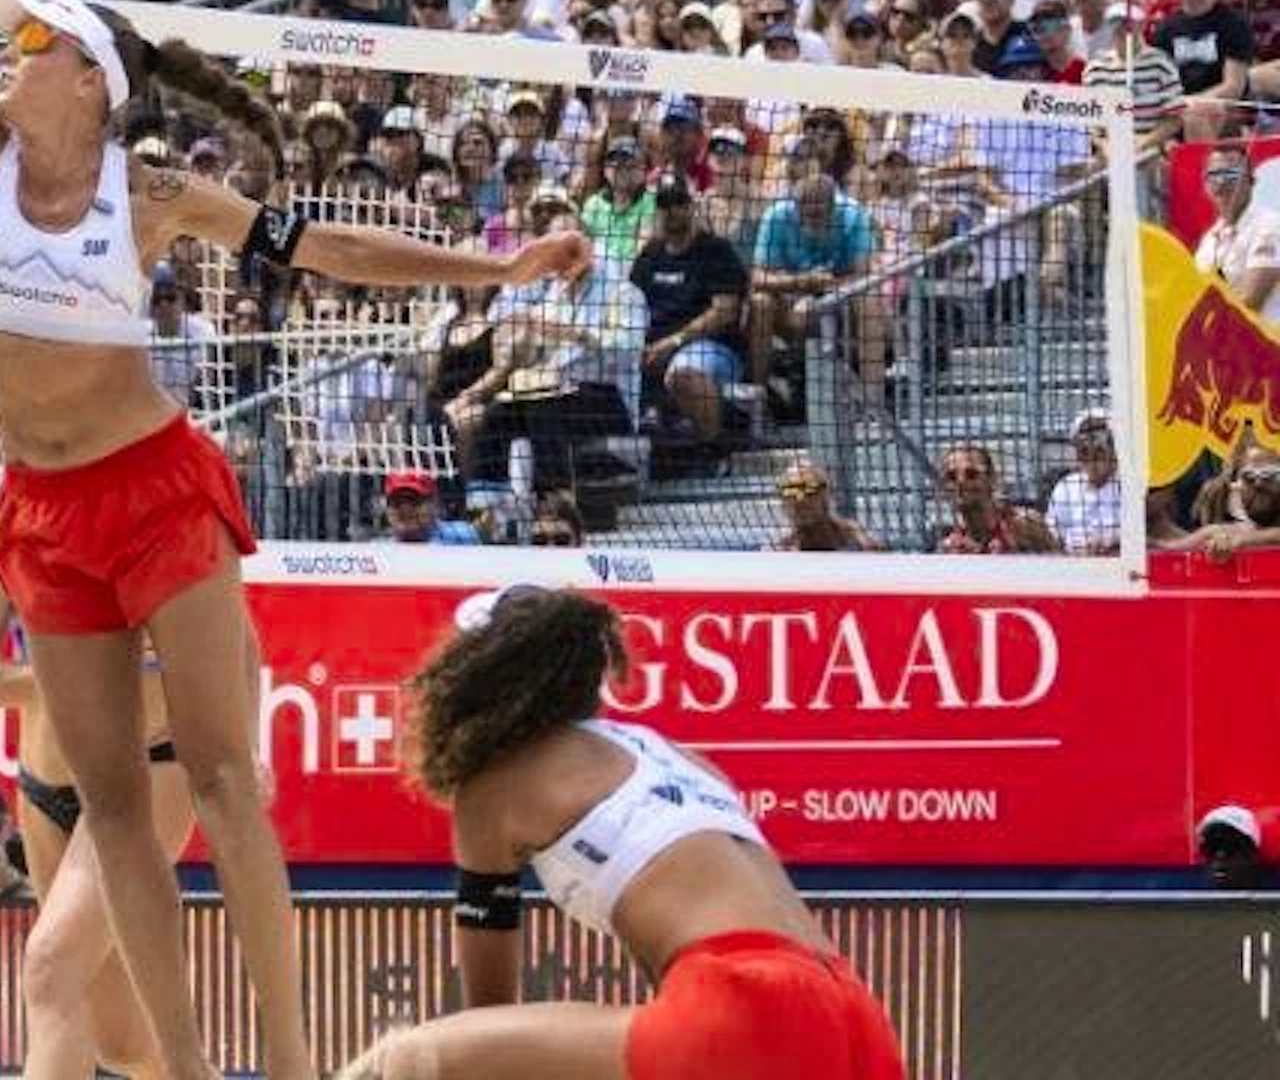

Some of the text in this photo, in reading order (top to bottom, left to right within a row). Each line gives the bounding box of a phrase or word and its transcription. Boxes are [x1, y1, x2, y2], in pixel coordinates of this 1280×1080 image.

[281, 29, 359, 56] swatch
[1040, 94, 1104, 117] Senoh
[600, 607, 1060, 713] GSTAAD
[804, 789, 890, 820] SLOW
[898, 789, 996, 820] DOWN
